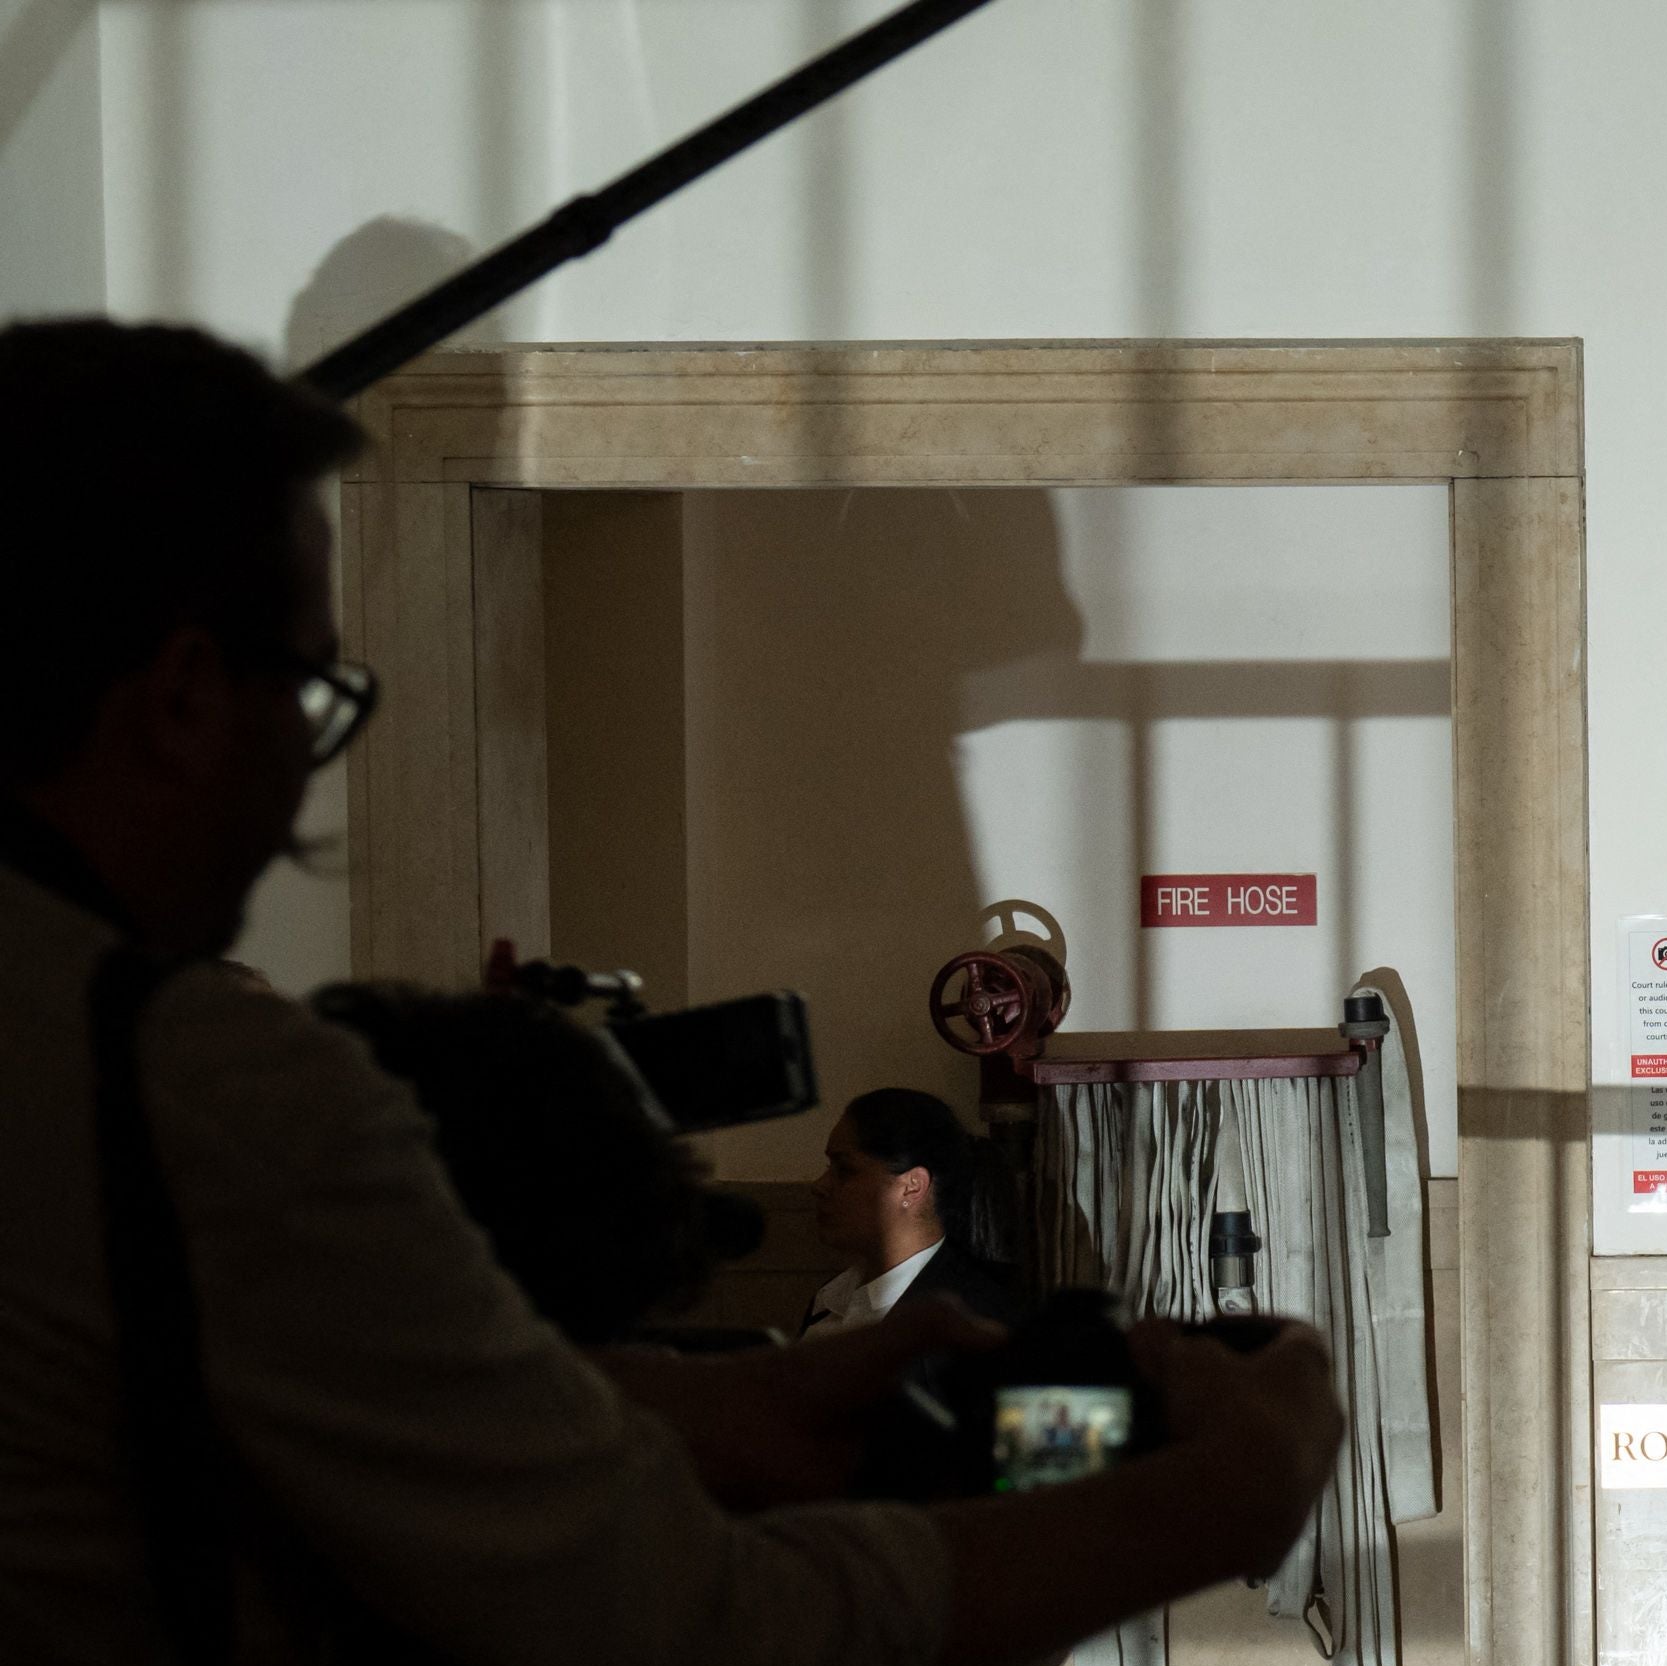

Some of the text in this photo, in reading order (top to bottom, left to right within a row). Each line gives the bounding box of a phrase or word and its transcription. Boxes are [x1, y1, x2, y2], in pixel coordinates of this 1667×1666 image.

[1157, 885, 1298, 915] FIRE HOSE
[1632, 981, 1653, 989] Court
[1652, 1111, 1661, 1119] de
